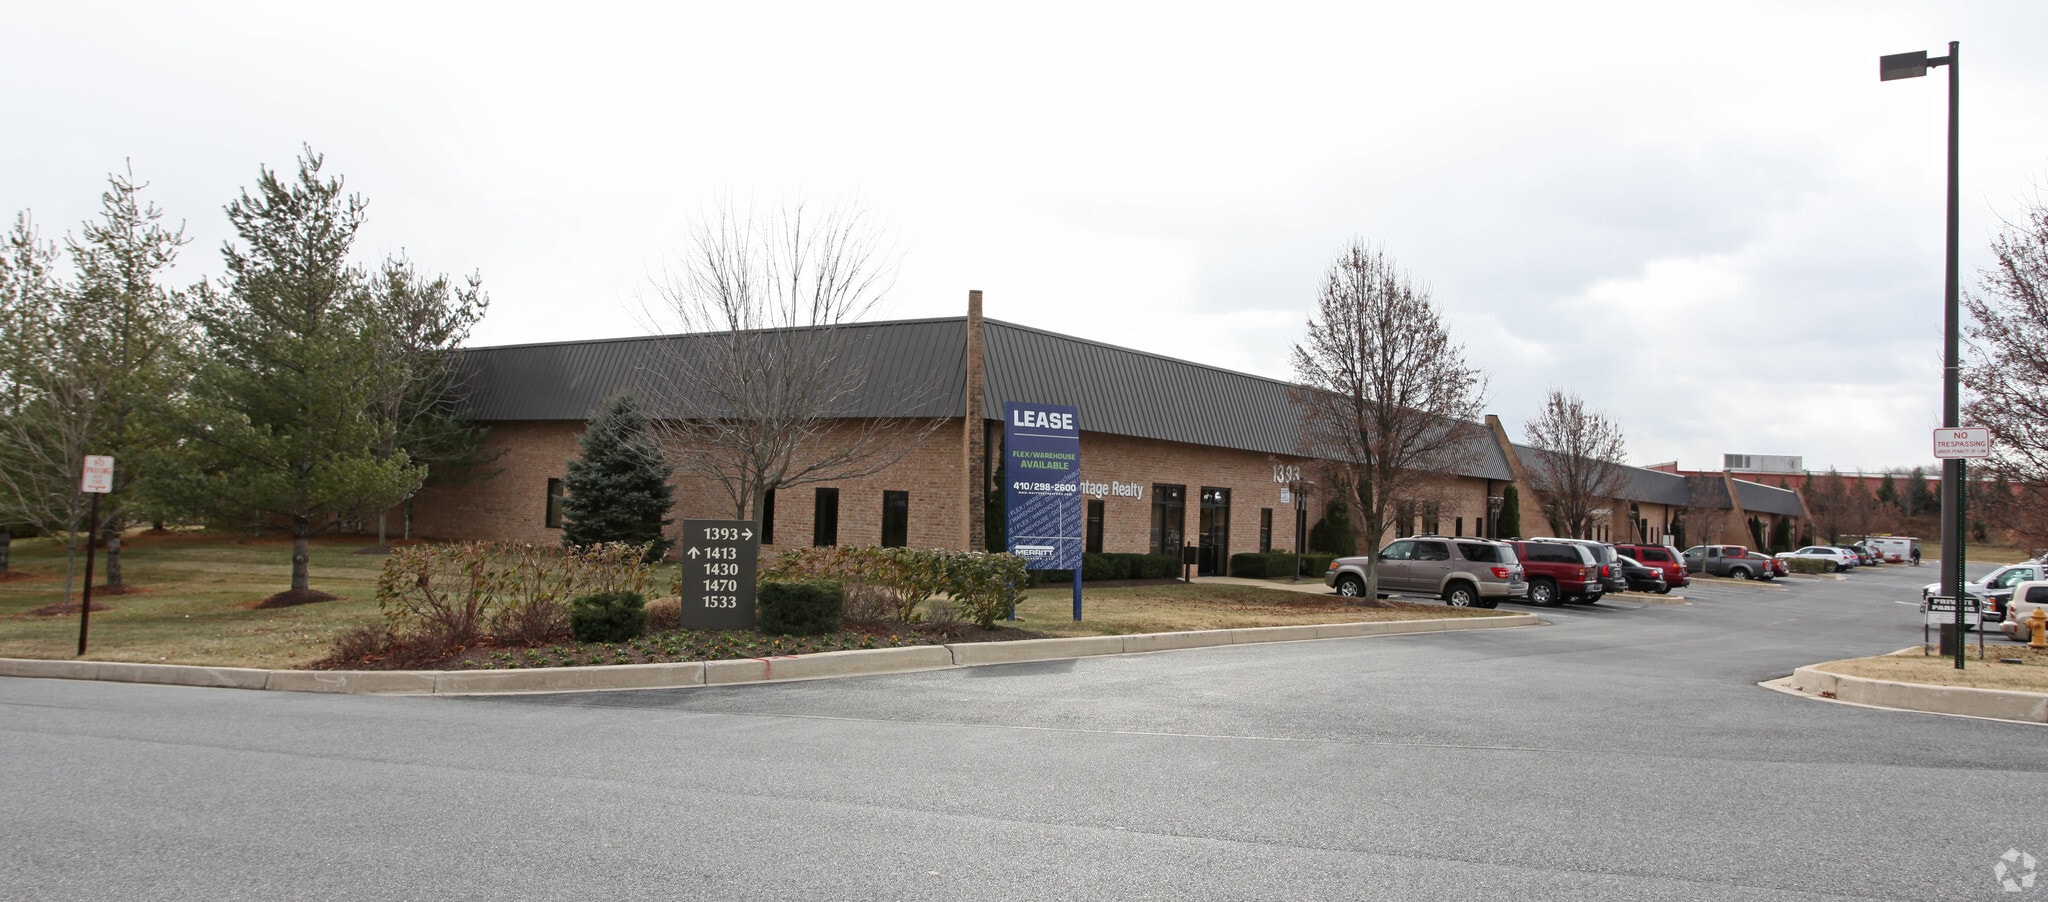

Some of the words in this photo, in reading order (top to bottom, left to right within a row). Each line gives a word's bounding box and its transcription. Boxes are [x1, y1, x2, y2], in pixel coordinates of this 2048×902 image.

[1013, 409, 1073, 430] LEASE
[1012, 450, 1076, 460] FLEX/WAREHOUSE
[1020, 460, 1069, 470] AVAILABLE
[1272, 464, 1300, 484] 1393
[1013, 482, 1077, 492] 410/298-2600
[1112, 481, 1143, 500] Realty
[703, 527, 738, 540] 1393
[704, 547, 737, 560] 1413
[703, 563, 738, 575] 1430
[703, 579, 737, 592] 1470
[702, 595, 737, 608] 1533
